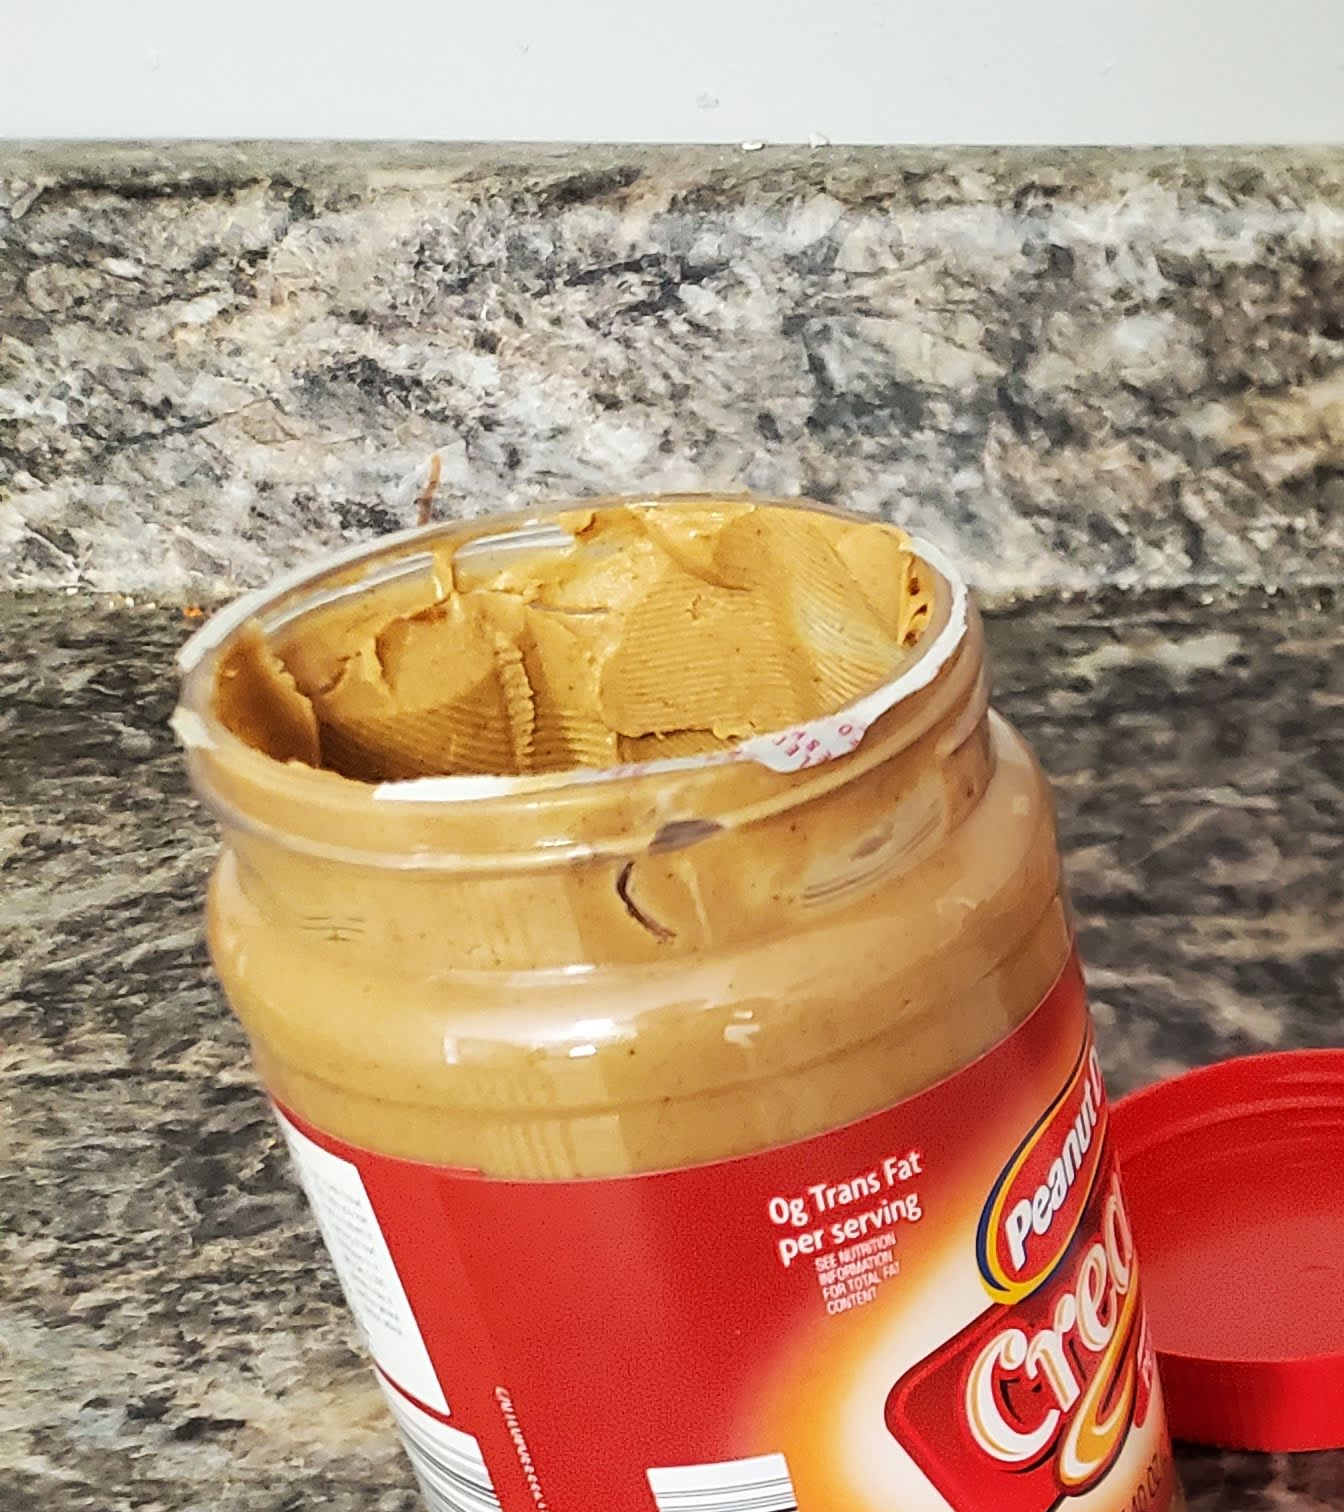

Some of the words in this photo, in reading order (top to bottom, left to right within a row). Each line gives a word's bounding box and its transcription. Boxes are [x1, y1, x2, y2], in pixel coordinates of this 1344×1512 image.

[809, 1172, 880, 1212] Trans
[883, 1151, 922, 1186] Fat
[1004, 1100, 1098, 1272] Peanut
[779, 1229, 824, 1268] per
[831, 1193, 922, 1244] serving
[815, 1253, 837, 1272] SEE
[838, 1232, 897, 1266] NUTRITION
[818, 1251, 893, 1286] INFORMATION
[823, 1283, 847, 1301] FOR
[847, 1272, 881, 1294] TOTAL
[883, 1262, 900, 1280] FAT
[826, 1287, 877, 1316] CONTENT
